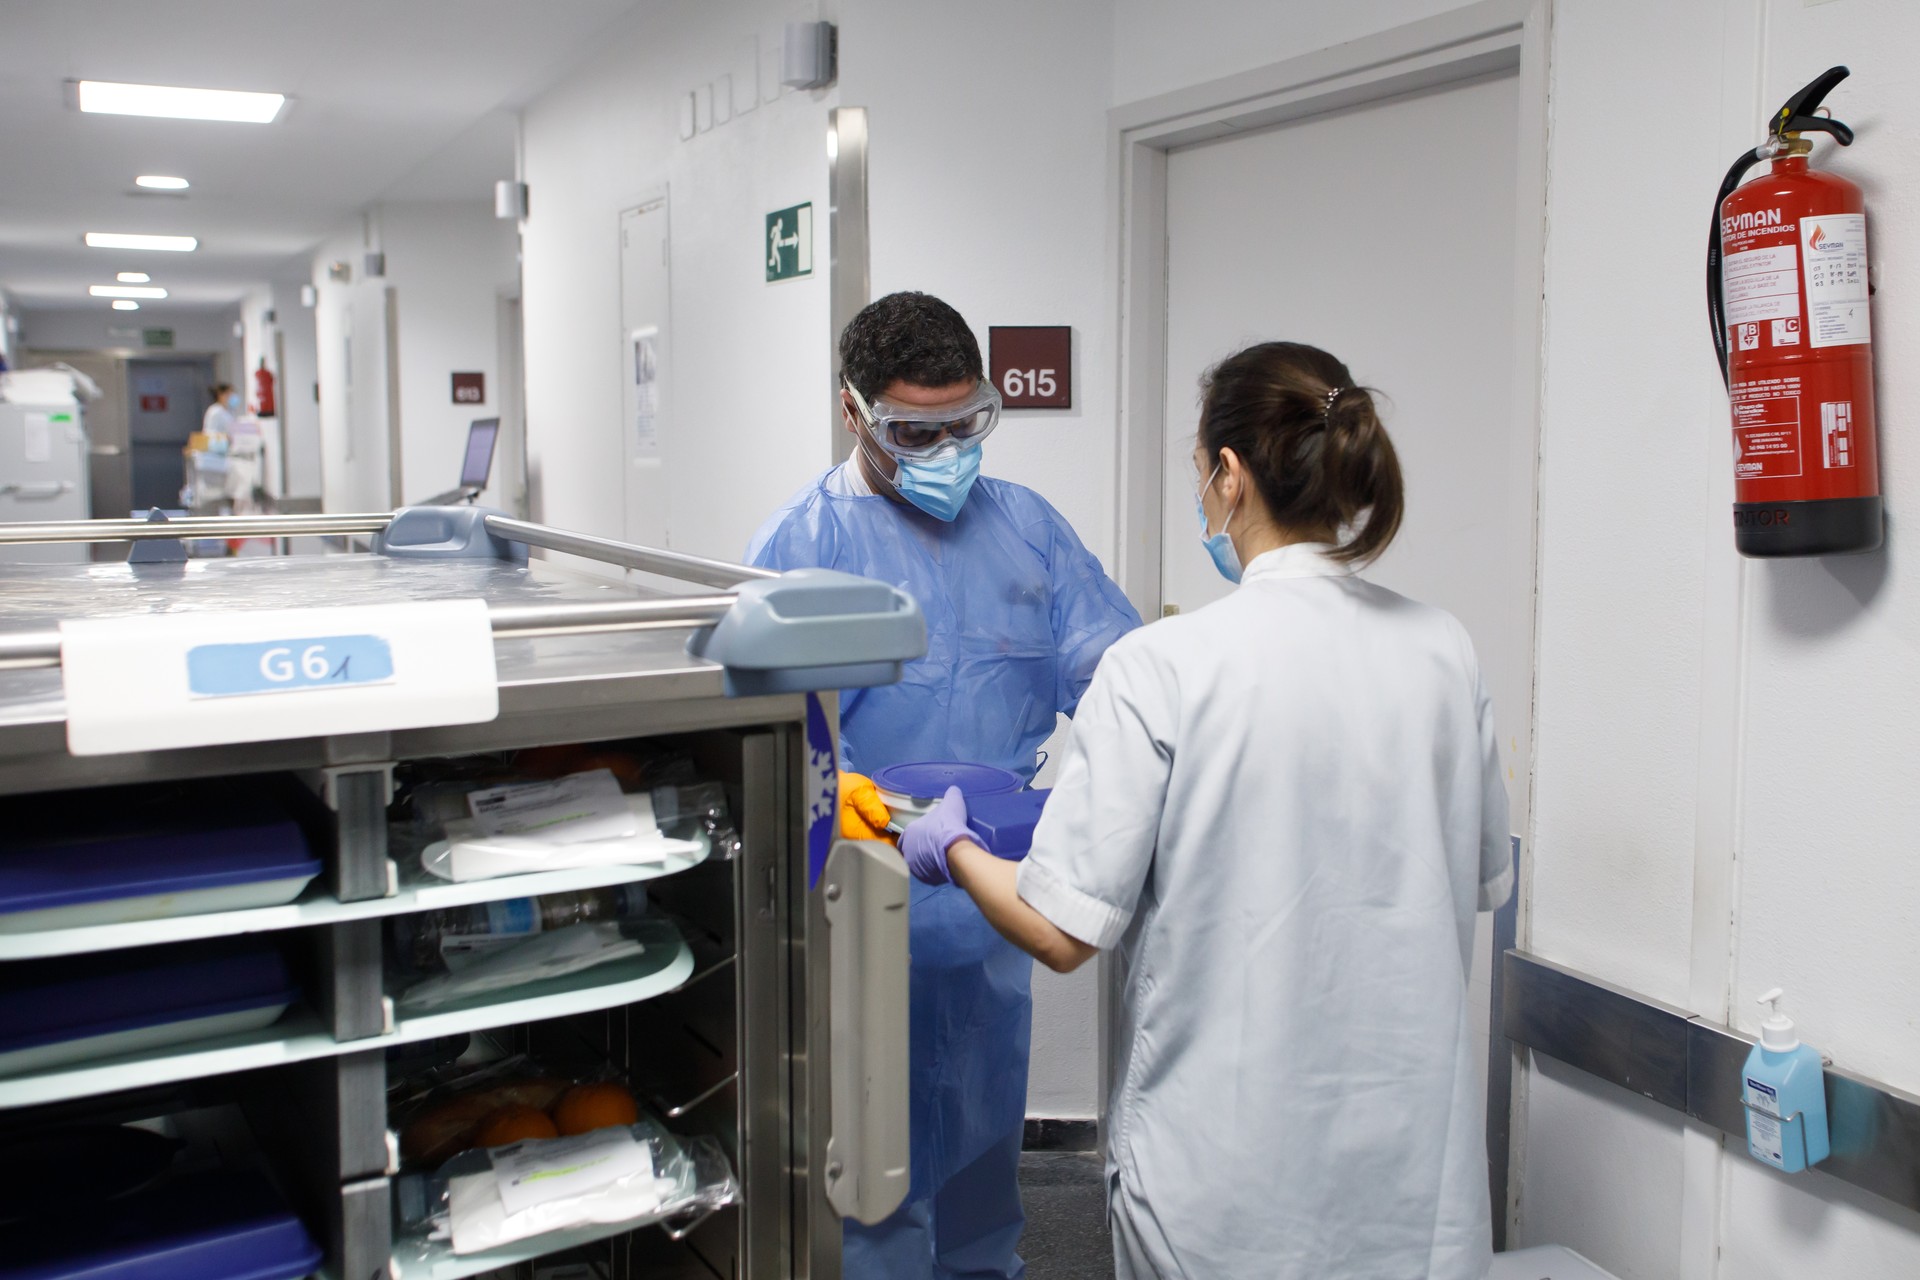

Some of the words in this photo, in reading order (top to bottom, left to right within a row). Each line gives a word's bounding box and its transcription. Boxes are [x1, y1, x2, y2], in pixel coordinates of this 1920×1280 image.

[1722, 208, 1781, 235] SEYMAN
[1737, 230, 1747, 240] DE
[1748, 224, 1796, 237] INCENDIOS
[1748, 324, 1757, 336] B
[1786, 319, 1798, 331] C
[1003, 368, 1057, 397] 615
[260, 645, 331, 682] G6
